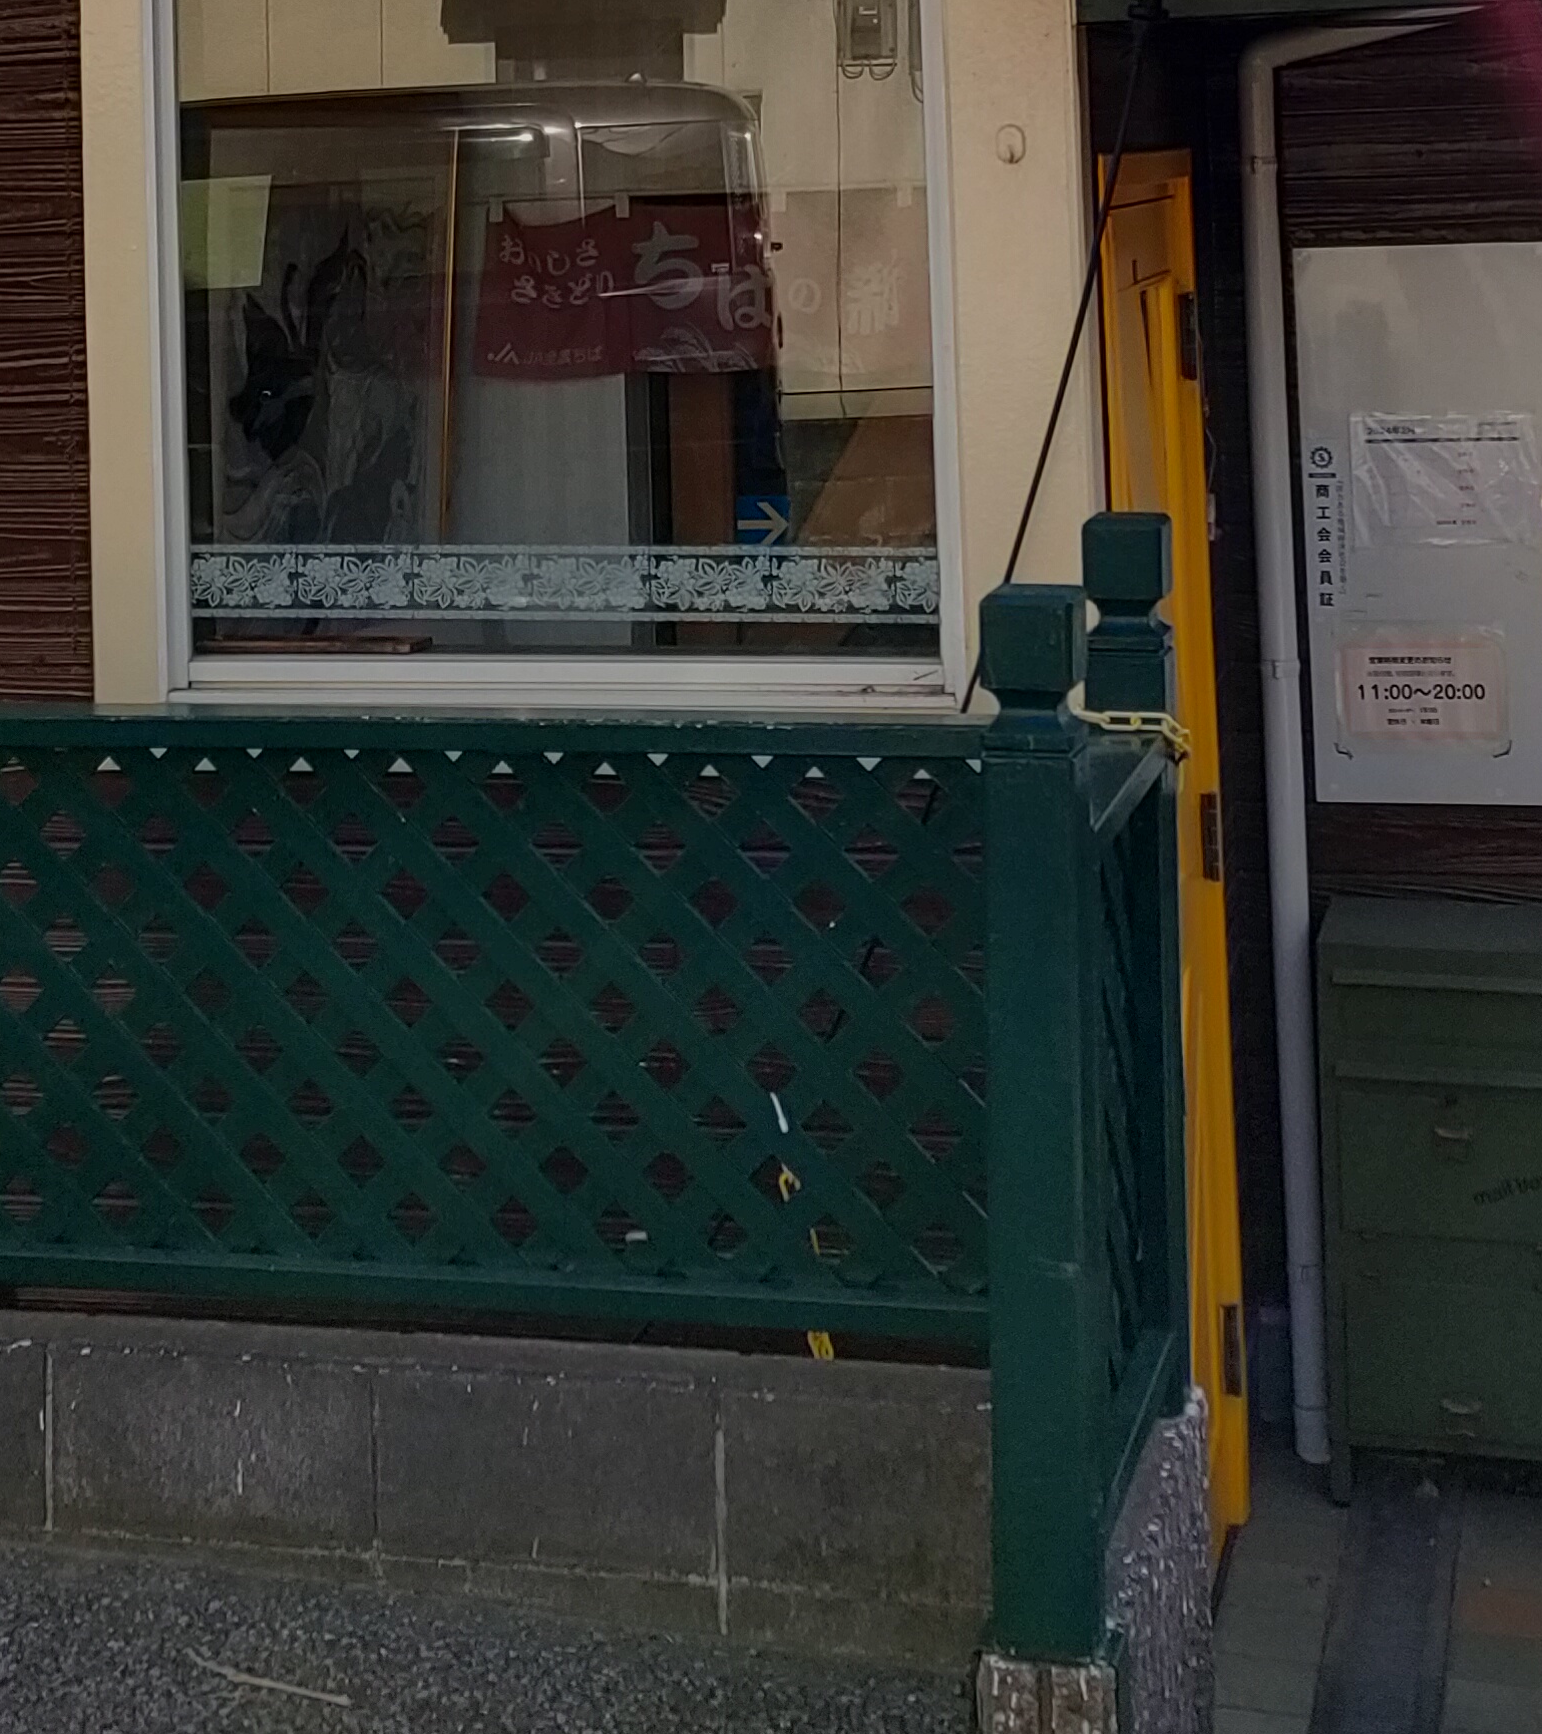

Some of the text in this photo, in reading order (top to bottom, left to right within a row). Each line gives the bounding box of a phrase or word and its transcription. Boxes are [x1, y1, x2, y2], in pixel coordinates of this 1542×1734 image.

[1315, 484, 1334, 607] 商工会会員証
